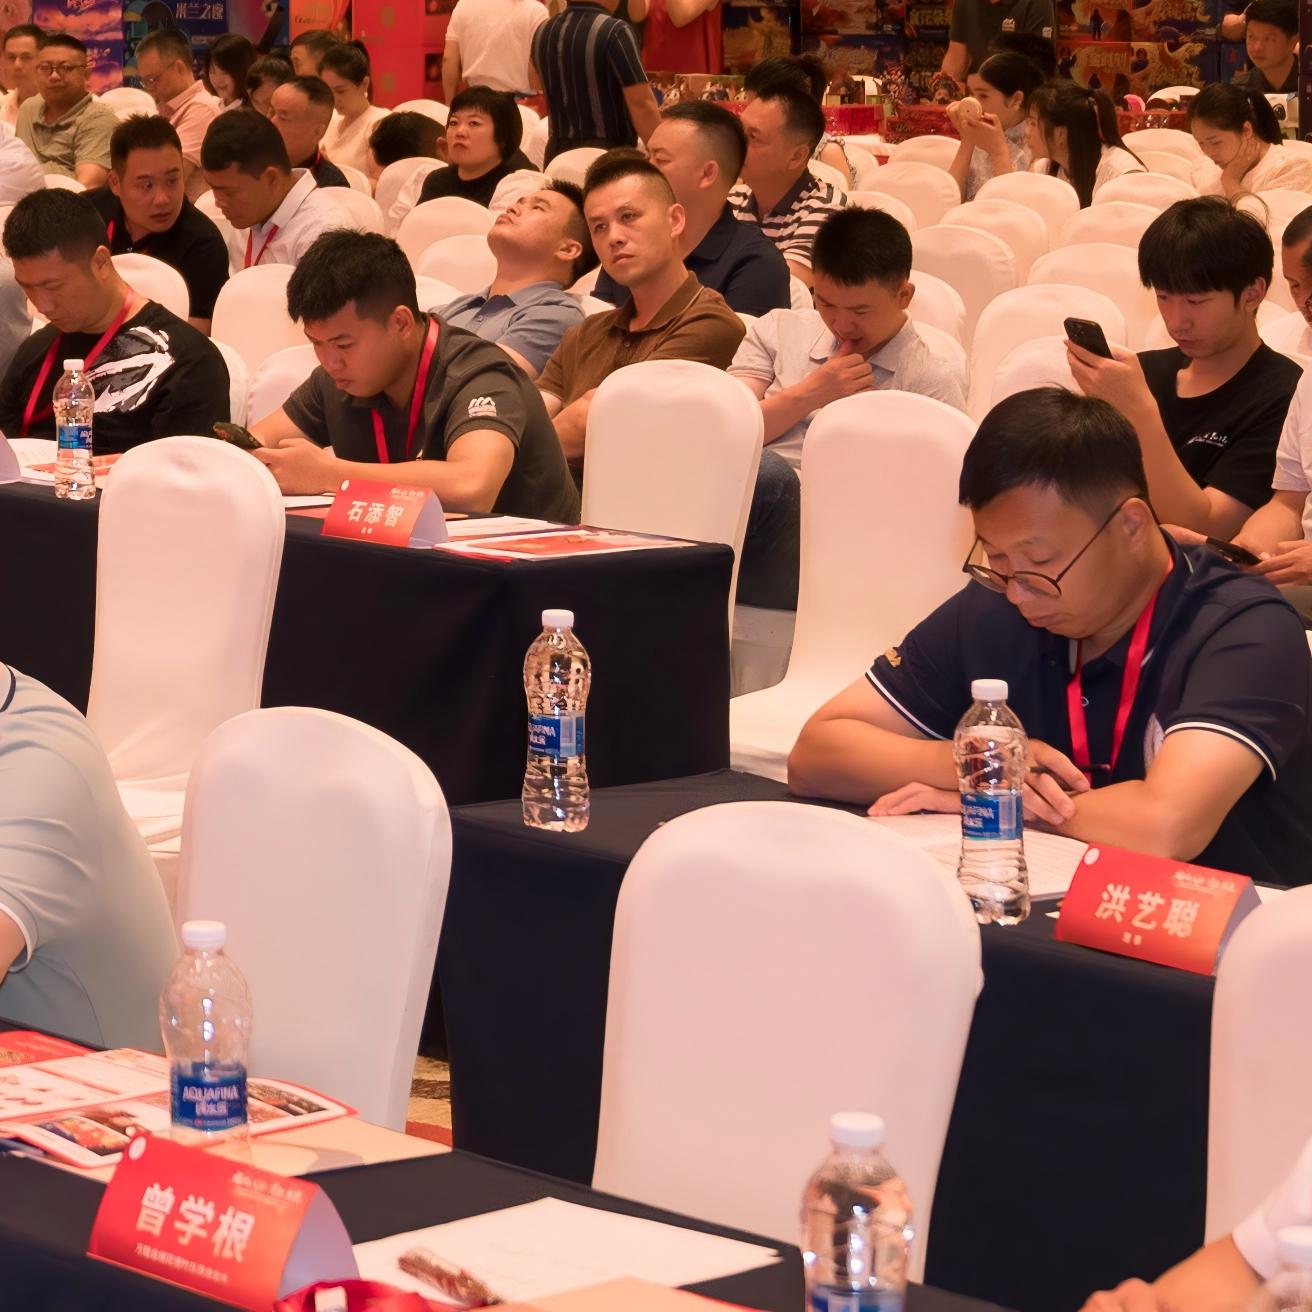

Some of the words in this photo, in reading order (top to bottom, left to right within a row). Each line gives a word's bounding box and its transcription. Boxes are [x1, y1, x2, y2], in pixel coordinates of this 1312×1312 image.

[347, 500, 405, 528] 石添智
[1095, 882, 1201, 938] 洪艺聪
[136, 1182, 256, 1263] 曾学根
